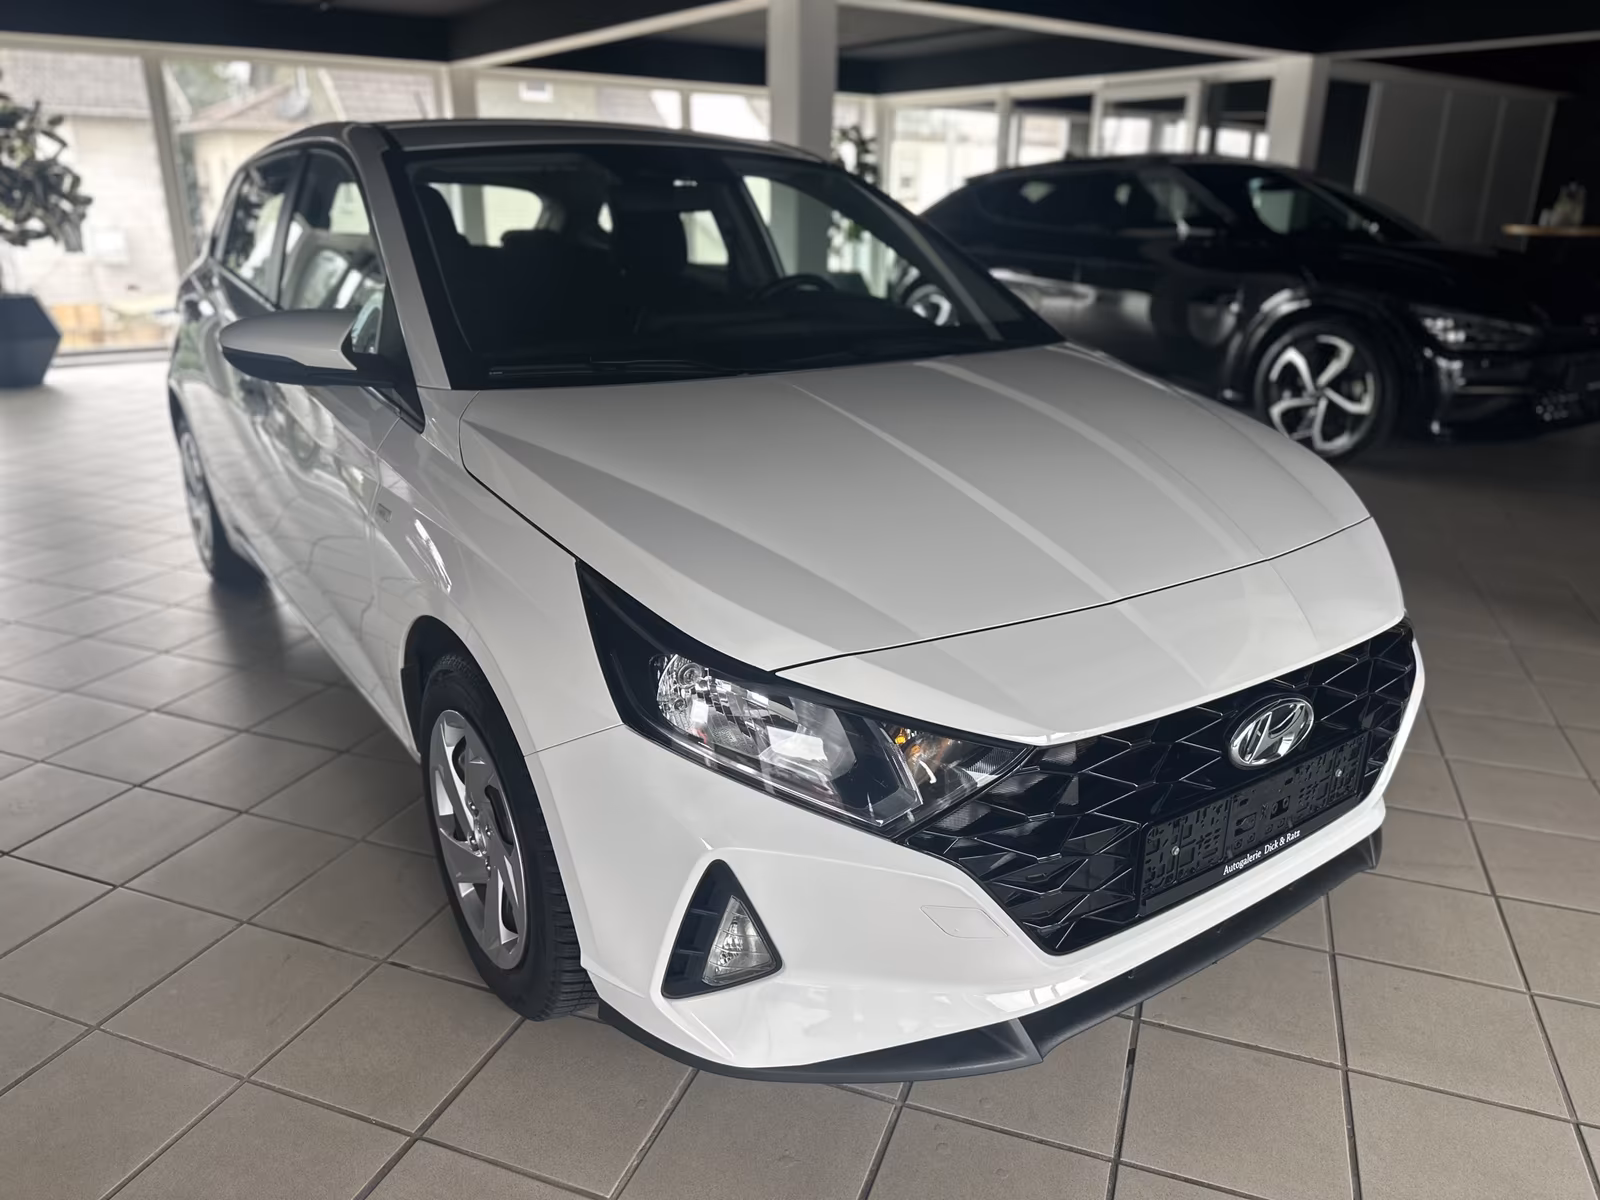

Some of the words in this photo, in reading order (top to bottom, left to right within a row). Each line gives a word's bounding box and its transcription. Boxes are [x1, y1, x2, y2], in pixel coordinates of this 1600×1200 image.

[1223, 850, 1262, 875] Autogalerie
[1264, 840, 1279, 854] Dick
[1279, 836, 1286, 846] &
[1286, 830, 1300, 842] Ratz
